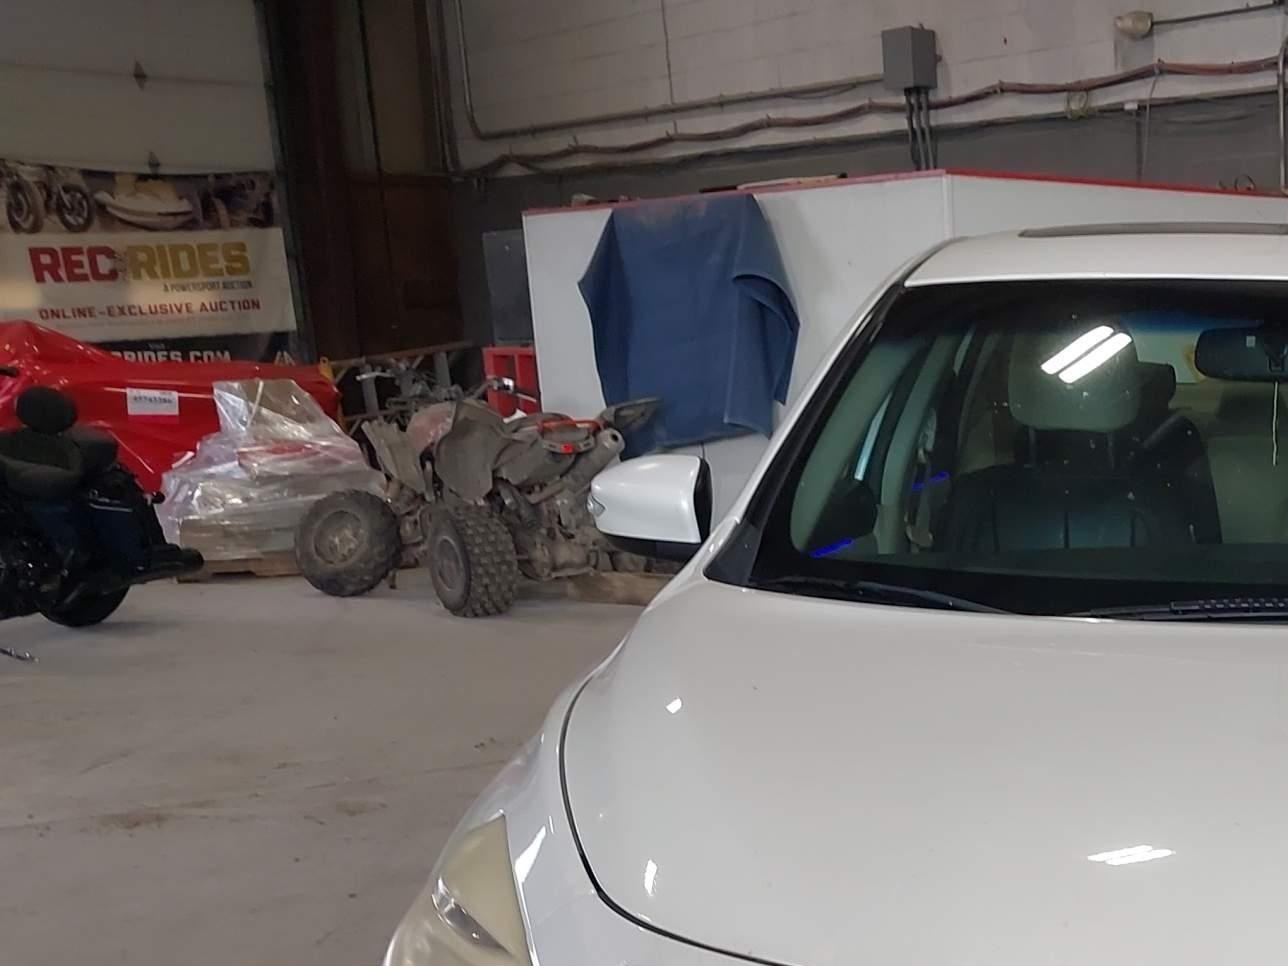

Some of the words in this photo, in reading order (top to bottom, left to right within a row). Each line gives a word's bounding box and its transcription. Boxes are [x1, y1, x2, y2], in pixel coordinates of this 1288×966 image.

[28, 244, 119, 284] REC
[125, 240, 251, 281] RIDES
[39, 302, 194, 321] ONLINE-EXCLUSIVE
[199, 299, 262, 314] AUCTION
